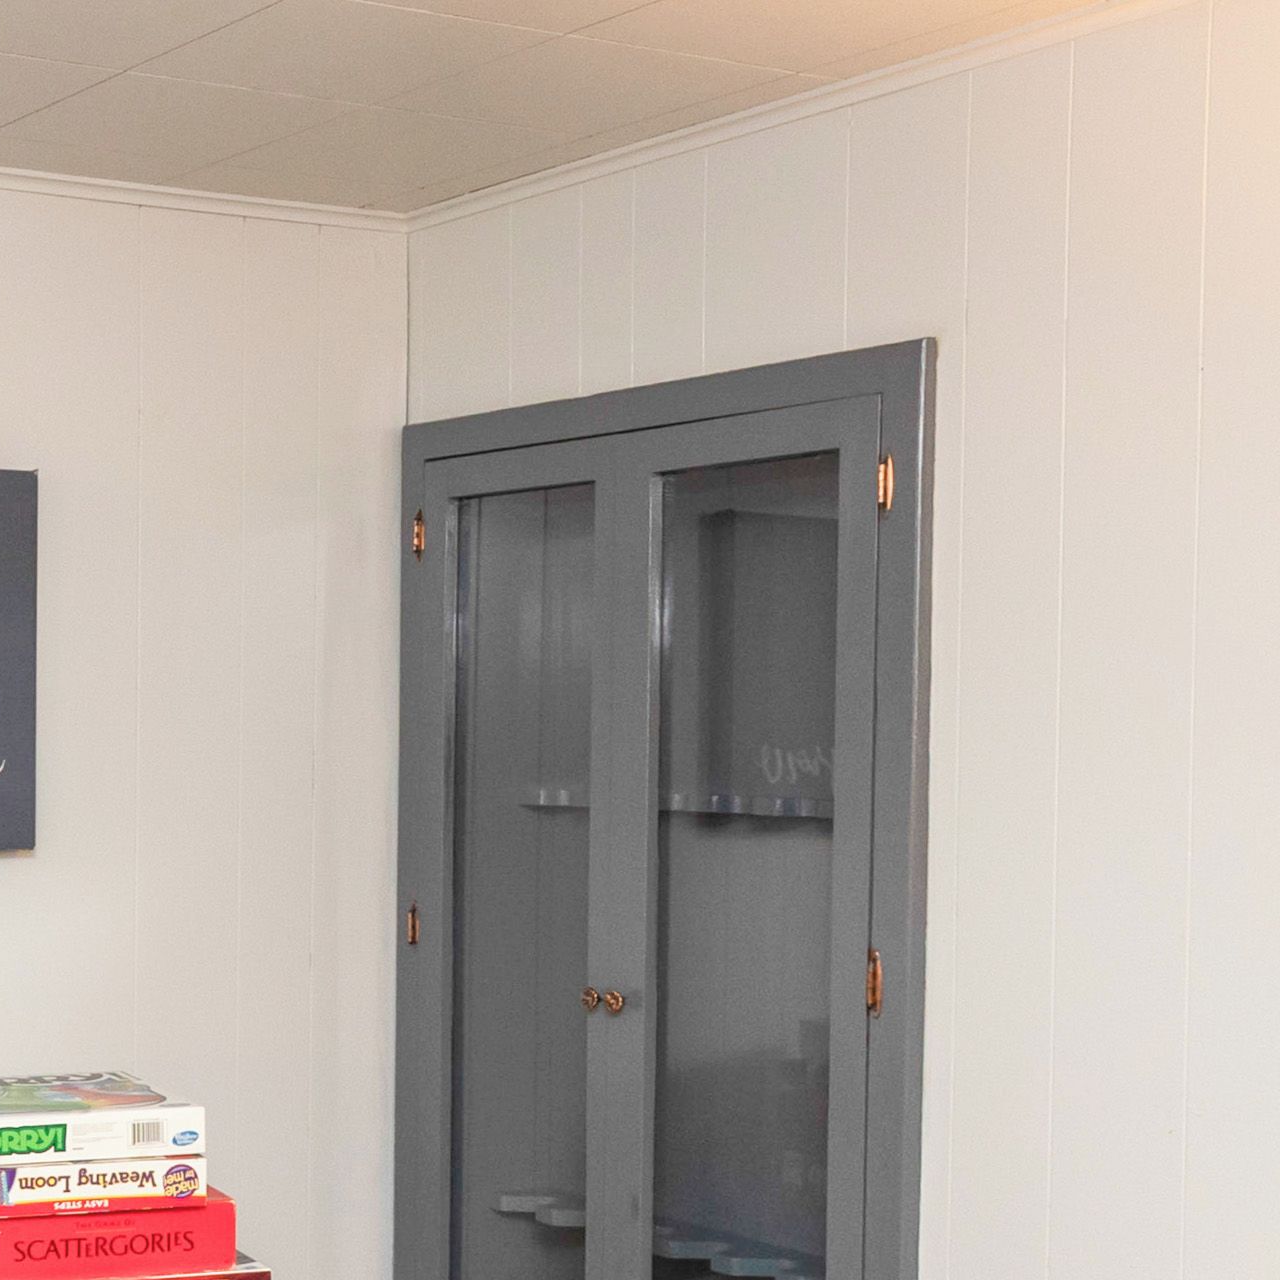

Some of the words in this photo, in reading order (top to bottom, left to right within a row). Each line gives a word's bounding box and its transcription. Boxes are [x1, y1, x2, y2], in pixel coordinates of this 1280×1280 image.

[18, 1174, 71, 1193] Loom
[77, 1168, 157, 1190] Weaving
[53, 1200, 83, 1211] STEPS
[85, 1198, 110, 1209] EASY
[14, 1229, 195, 1264] SCATTERGORIES
